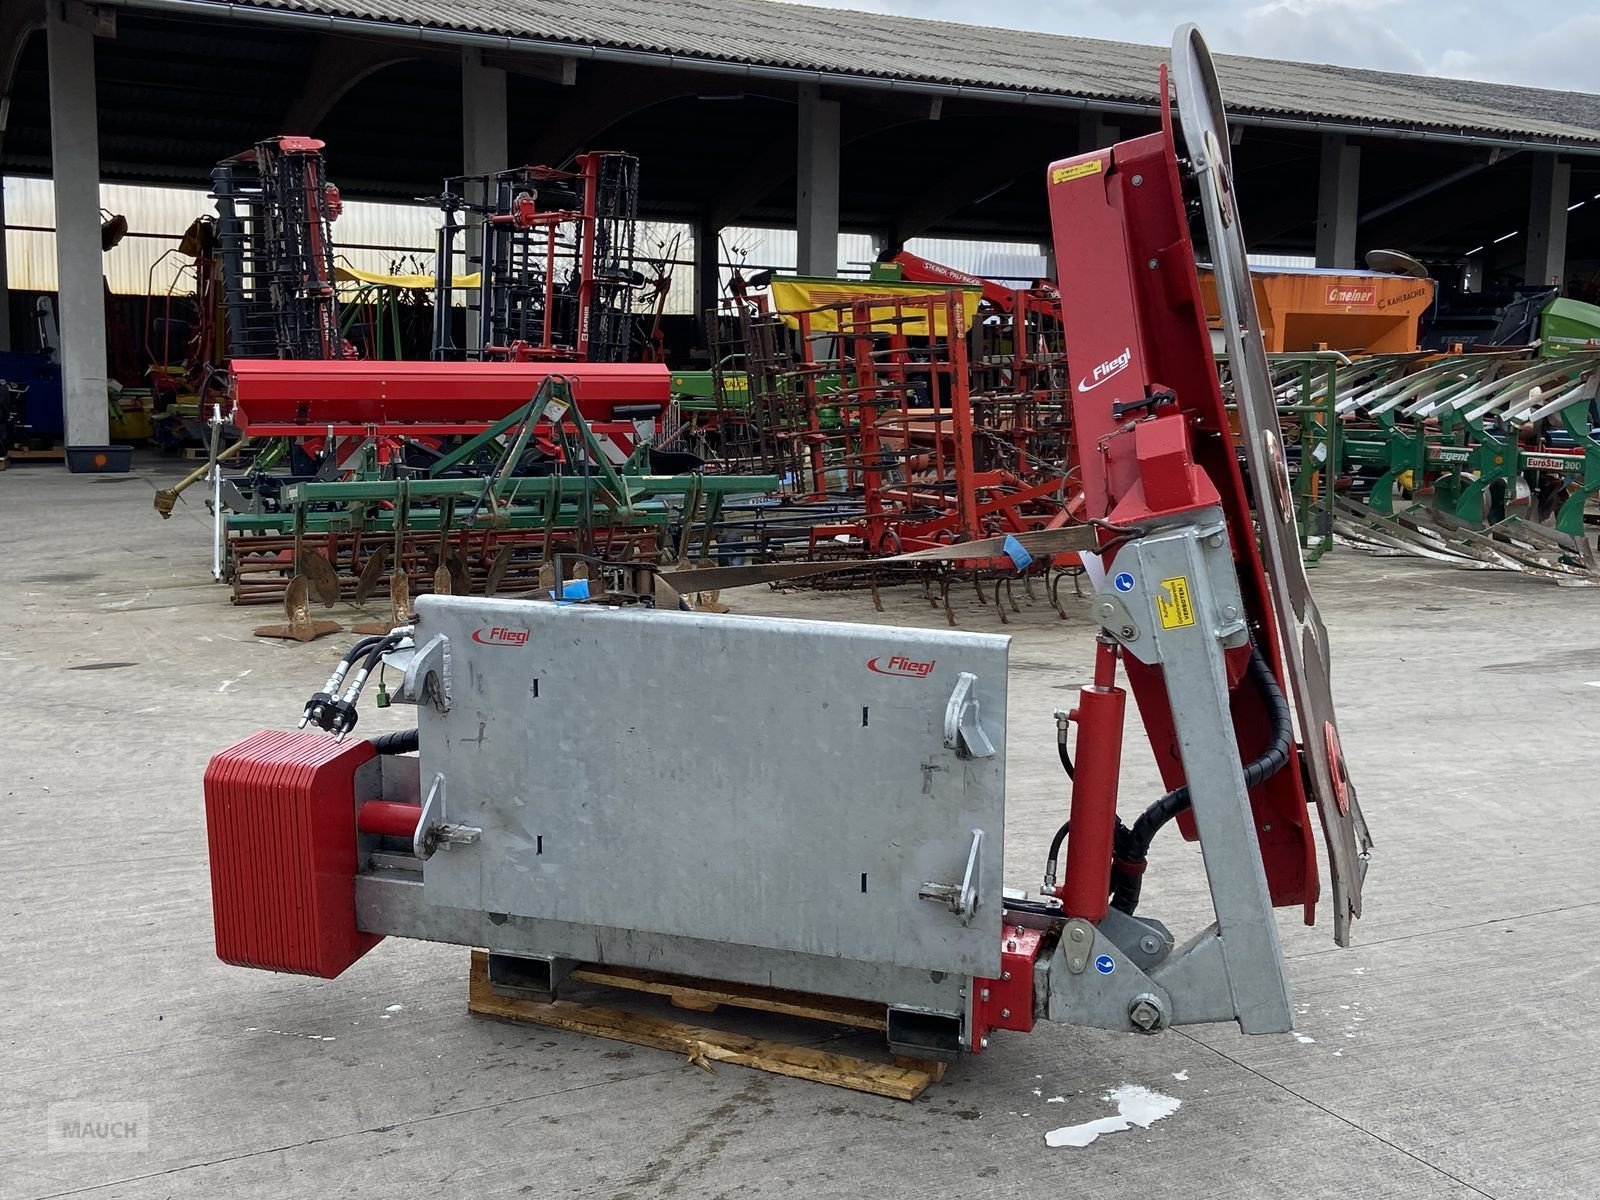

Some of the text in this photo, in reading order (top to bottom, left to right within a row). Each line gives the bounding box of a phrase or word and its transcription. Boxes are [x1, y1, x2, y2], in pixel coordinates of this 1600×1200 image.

[1329, 288, 1372, 303] Gmeiner
[1387, 287, 1426, 306] KAHLBACHER
[1093, 347, 1131, 381] Fliegl
[1527, 458, 1582, 470] EuroStar 300
[490, 627, 531, 644] Fliegl
[887, 656, 936, 676] Fliegl
